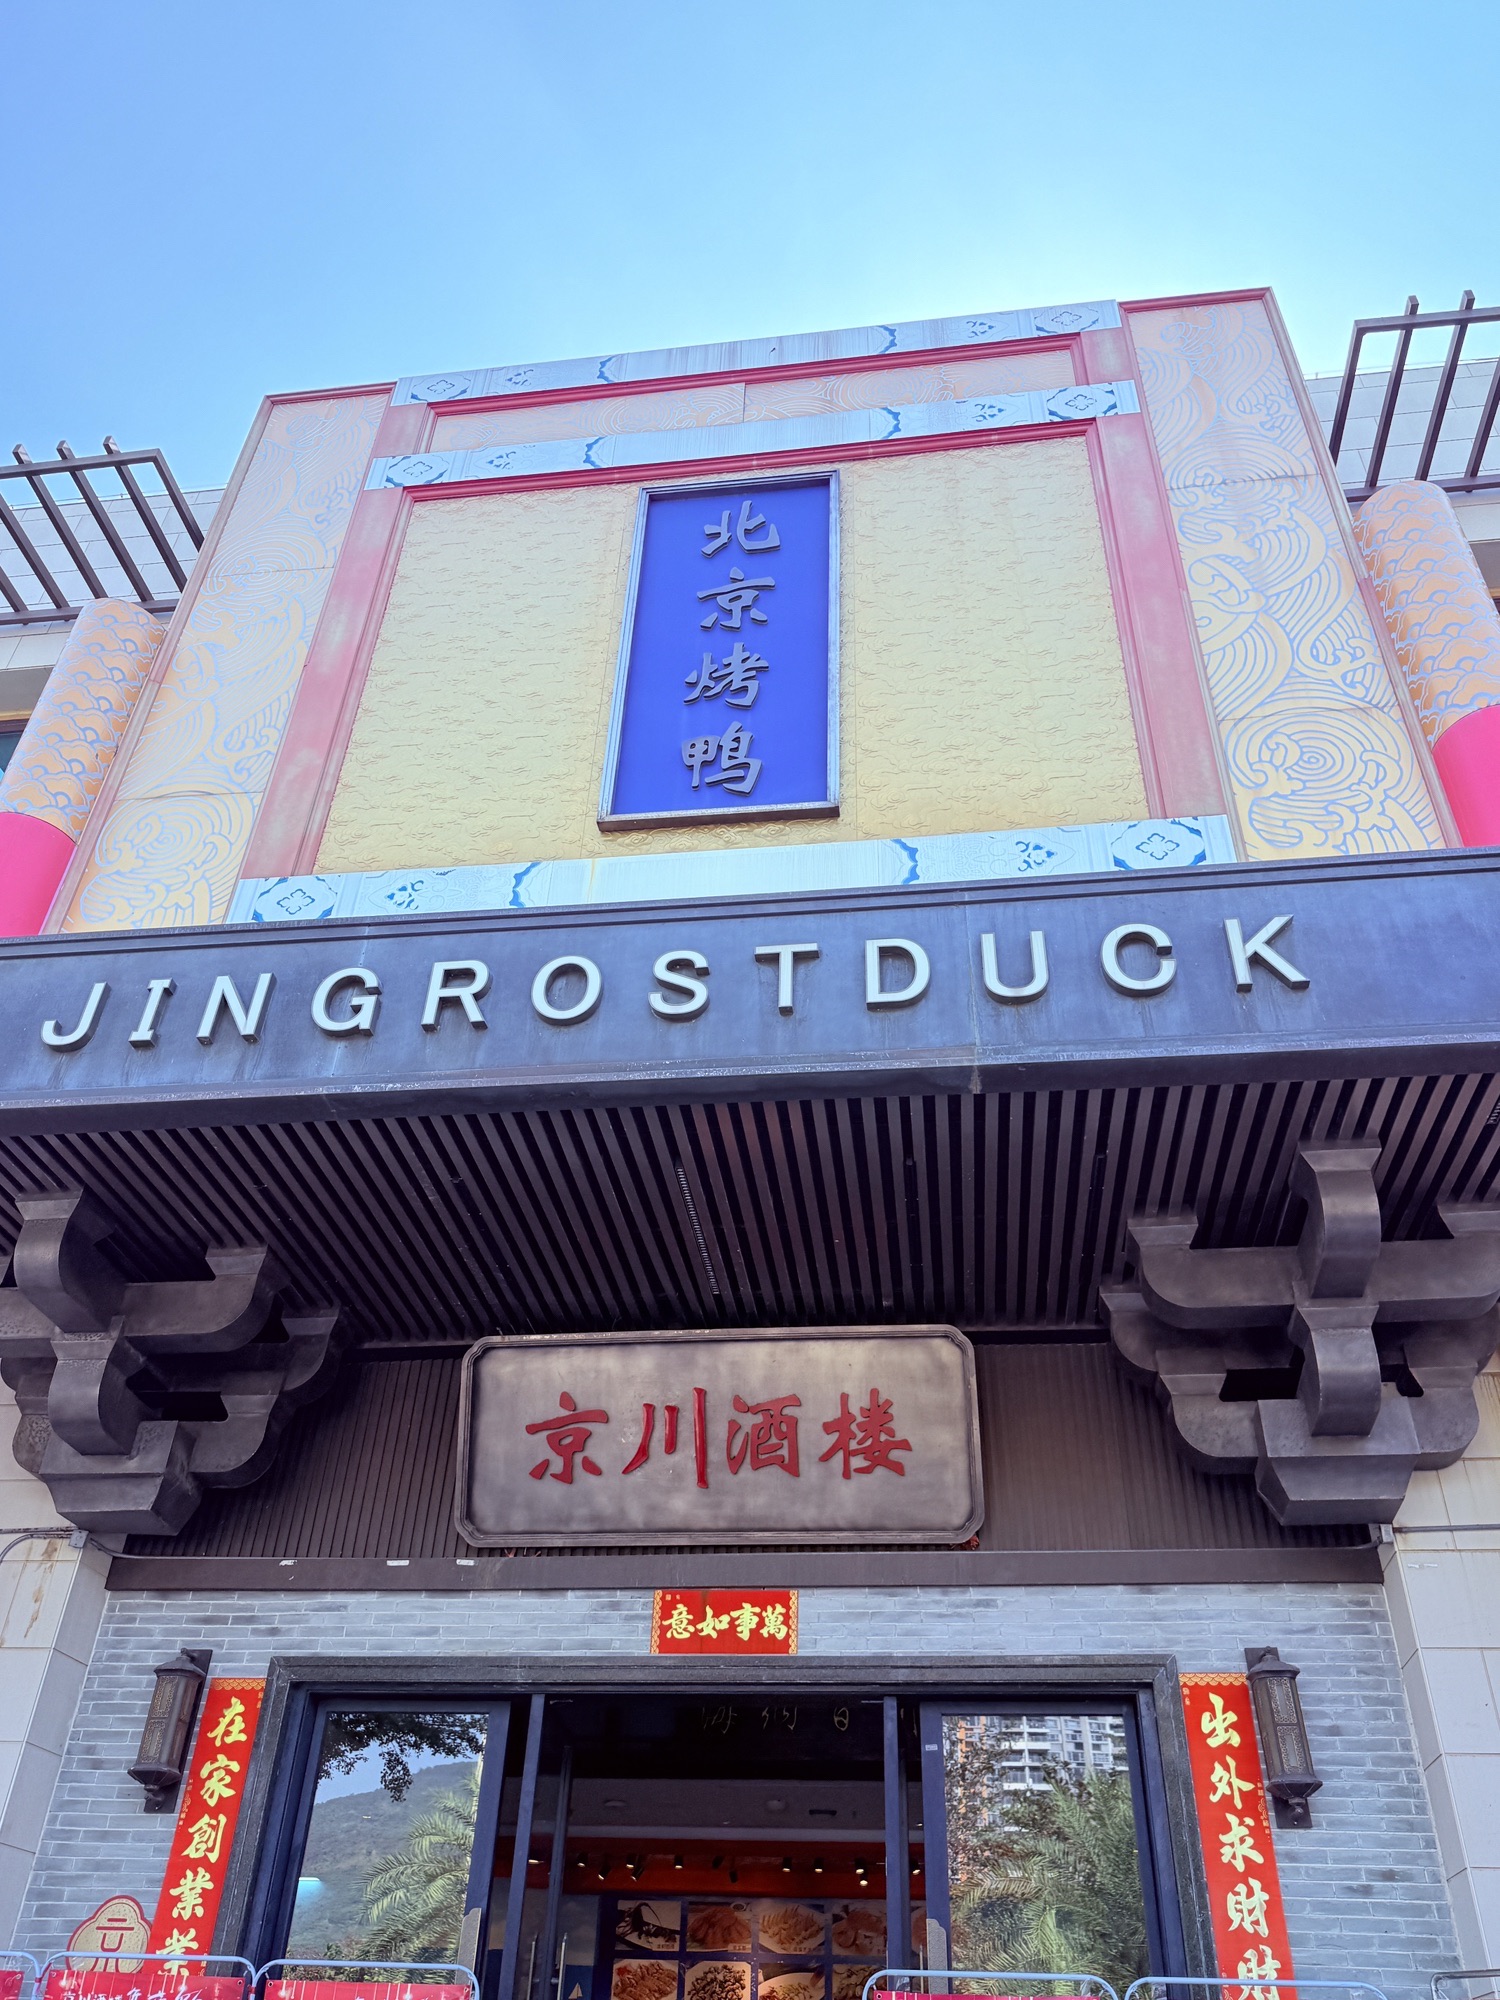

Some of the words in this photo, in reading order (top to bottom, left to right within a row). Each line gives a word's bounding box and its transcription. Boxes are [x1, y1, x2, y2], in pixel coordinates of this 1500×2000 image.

[681, 500, 781, 797] 北京烤鸭
[525, 1386, 913, 1489] 京川酒楼
